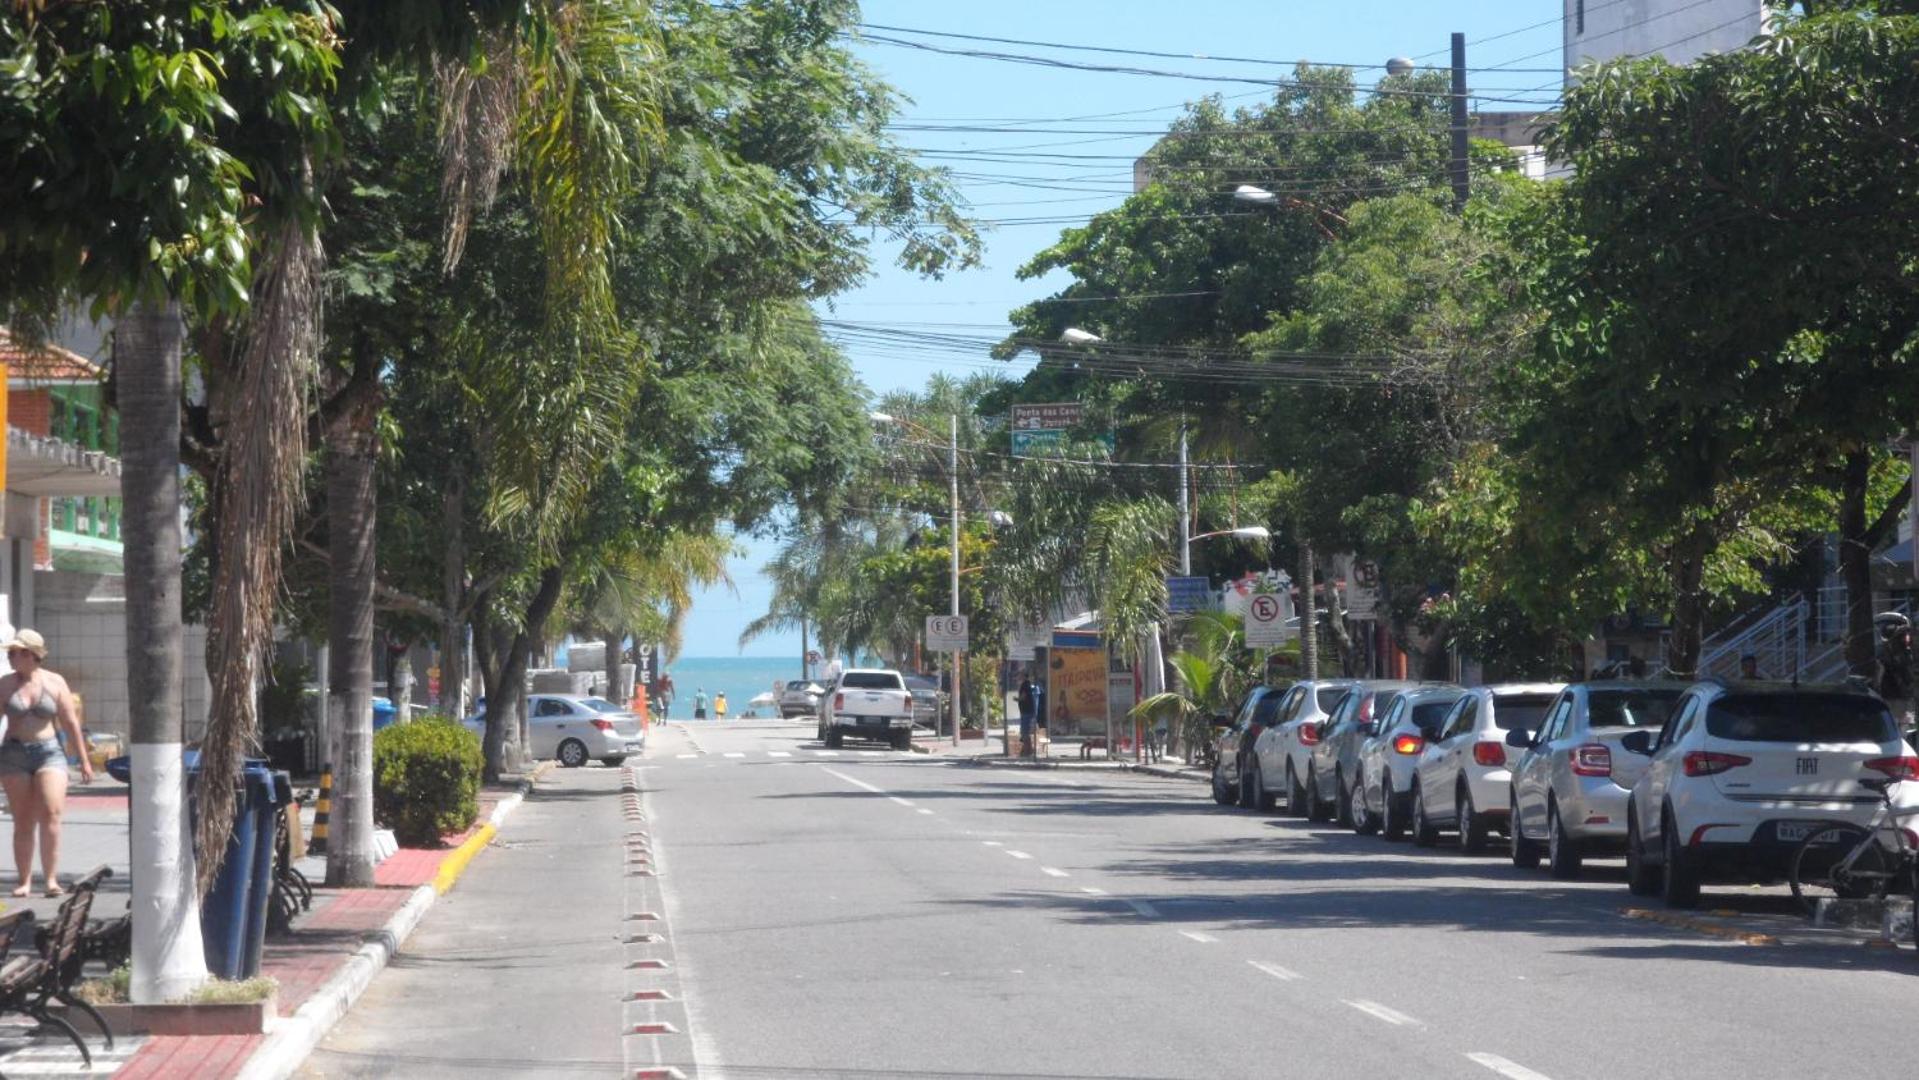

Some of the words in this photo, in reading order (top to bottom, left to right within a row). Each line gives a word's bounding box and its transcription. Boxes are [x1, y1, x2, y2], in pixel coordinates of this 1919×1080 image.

[1016, 408, 1040, 416] Ponta
[1042, 408, 1057, 416] das
[640, 644, 651, 683] OTE
[1796, 757, 1819, 775] FIAT
